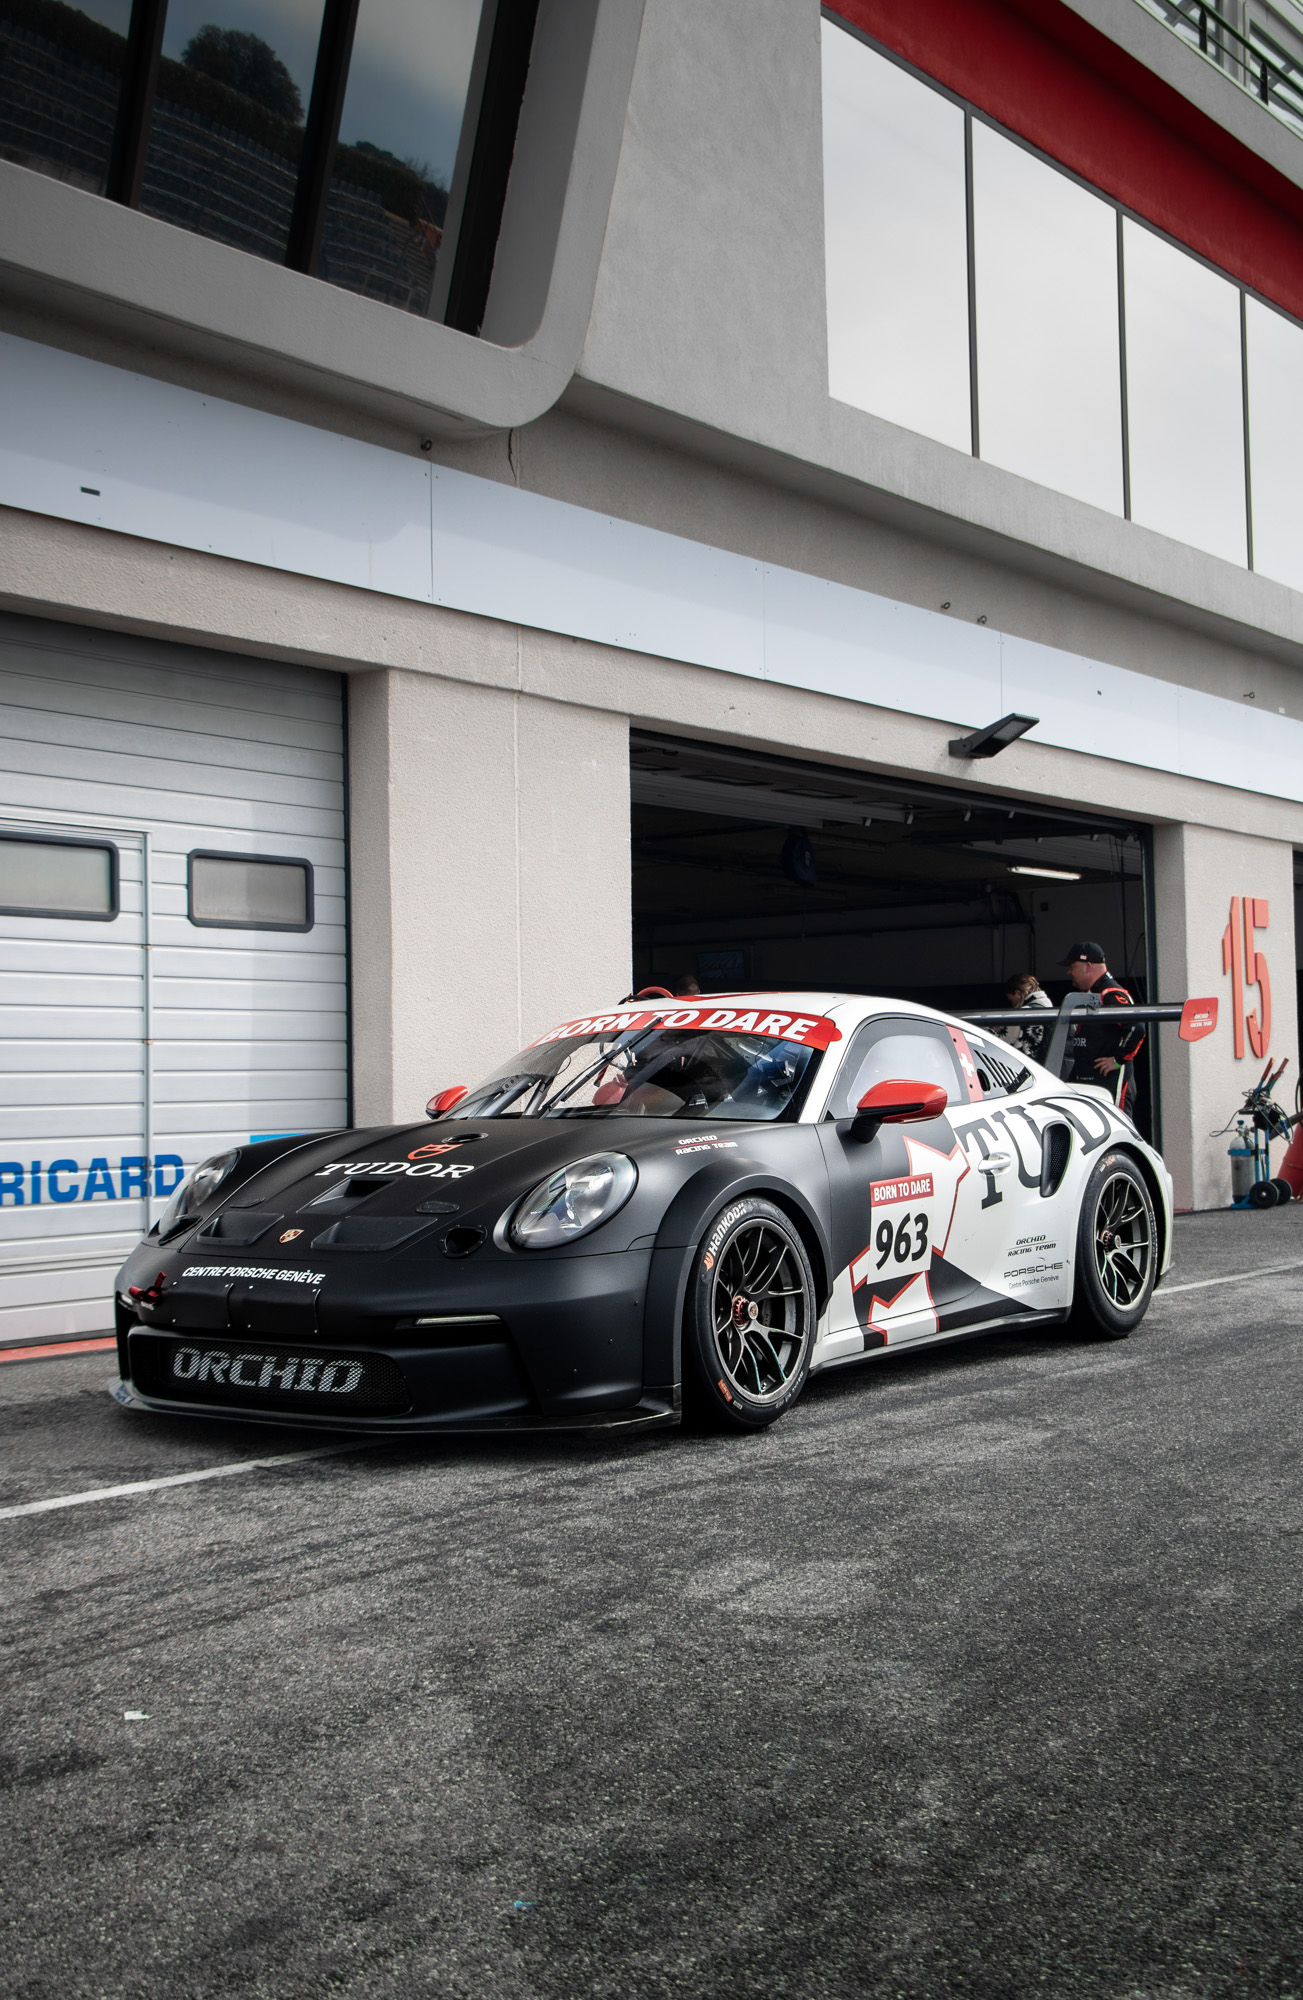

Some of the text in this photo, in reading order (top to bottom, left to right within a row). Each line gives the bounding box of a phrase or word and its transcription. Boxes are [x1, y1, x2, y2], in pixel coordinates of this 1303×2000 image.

[1222, 896, 1271, 1058] 15
[542, 1010, 819, 1042] BORN TO DARE
[678, 1134, 718, 1145] ORCHID
[0, 1154, 184, 1206] RICARD
[314, 1162, 475, 1179] TUDOR
[874, 1178, 931, 1201] BORN TO DARE
[876, 1212, 928, 1271] 963
[1016, 1234, 1046, 1245] ORCHID
[182, 1267, 326, 1285] CENTRE PORSCHE GENÈVE
[1004, 1262, 1063, 1279] PORSCHE
[1022, 1277, 1040, 1286] Porsche
[173, 1347, 365, 1393] ORCHID
